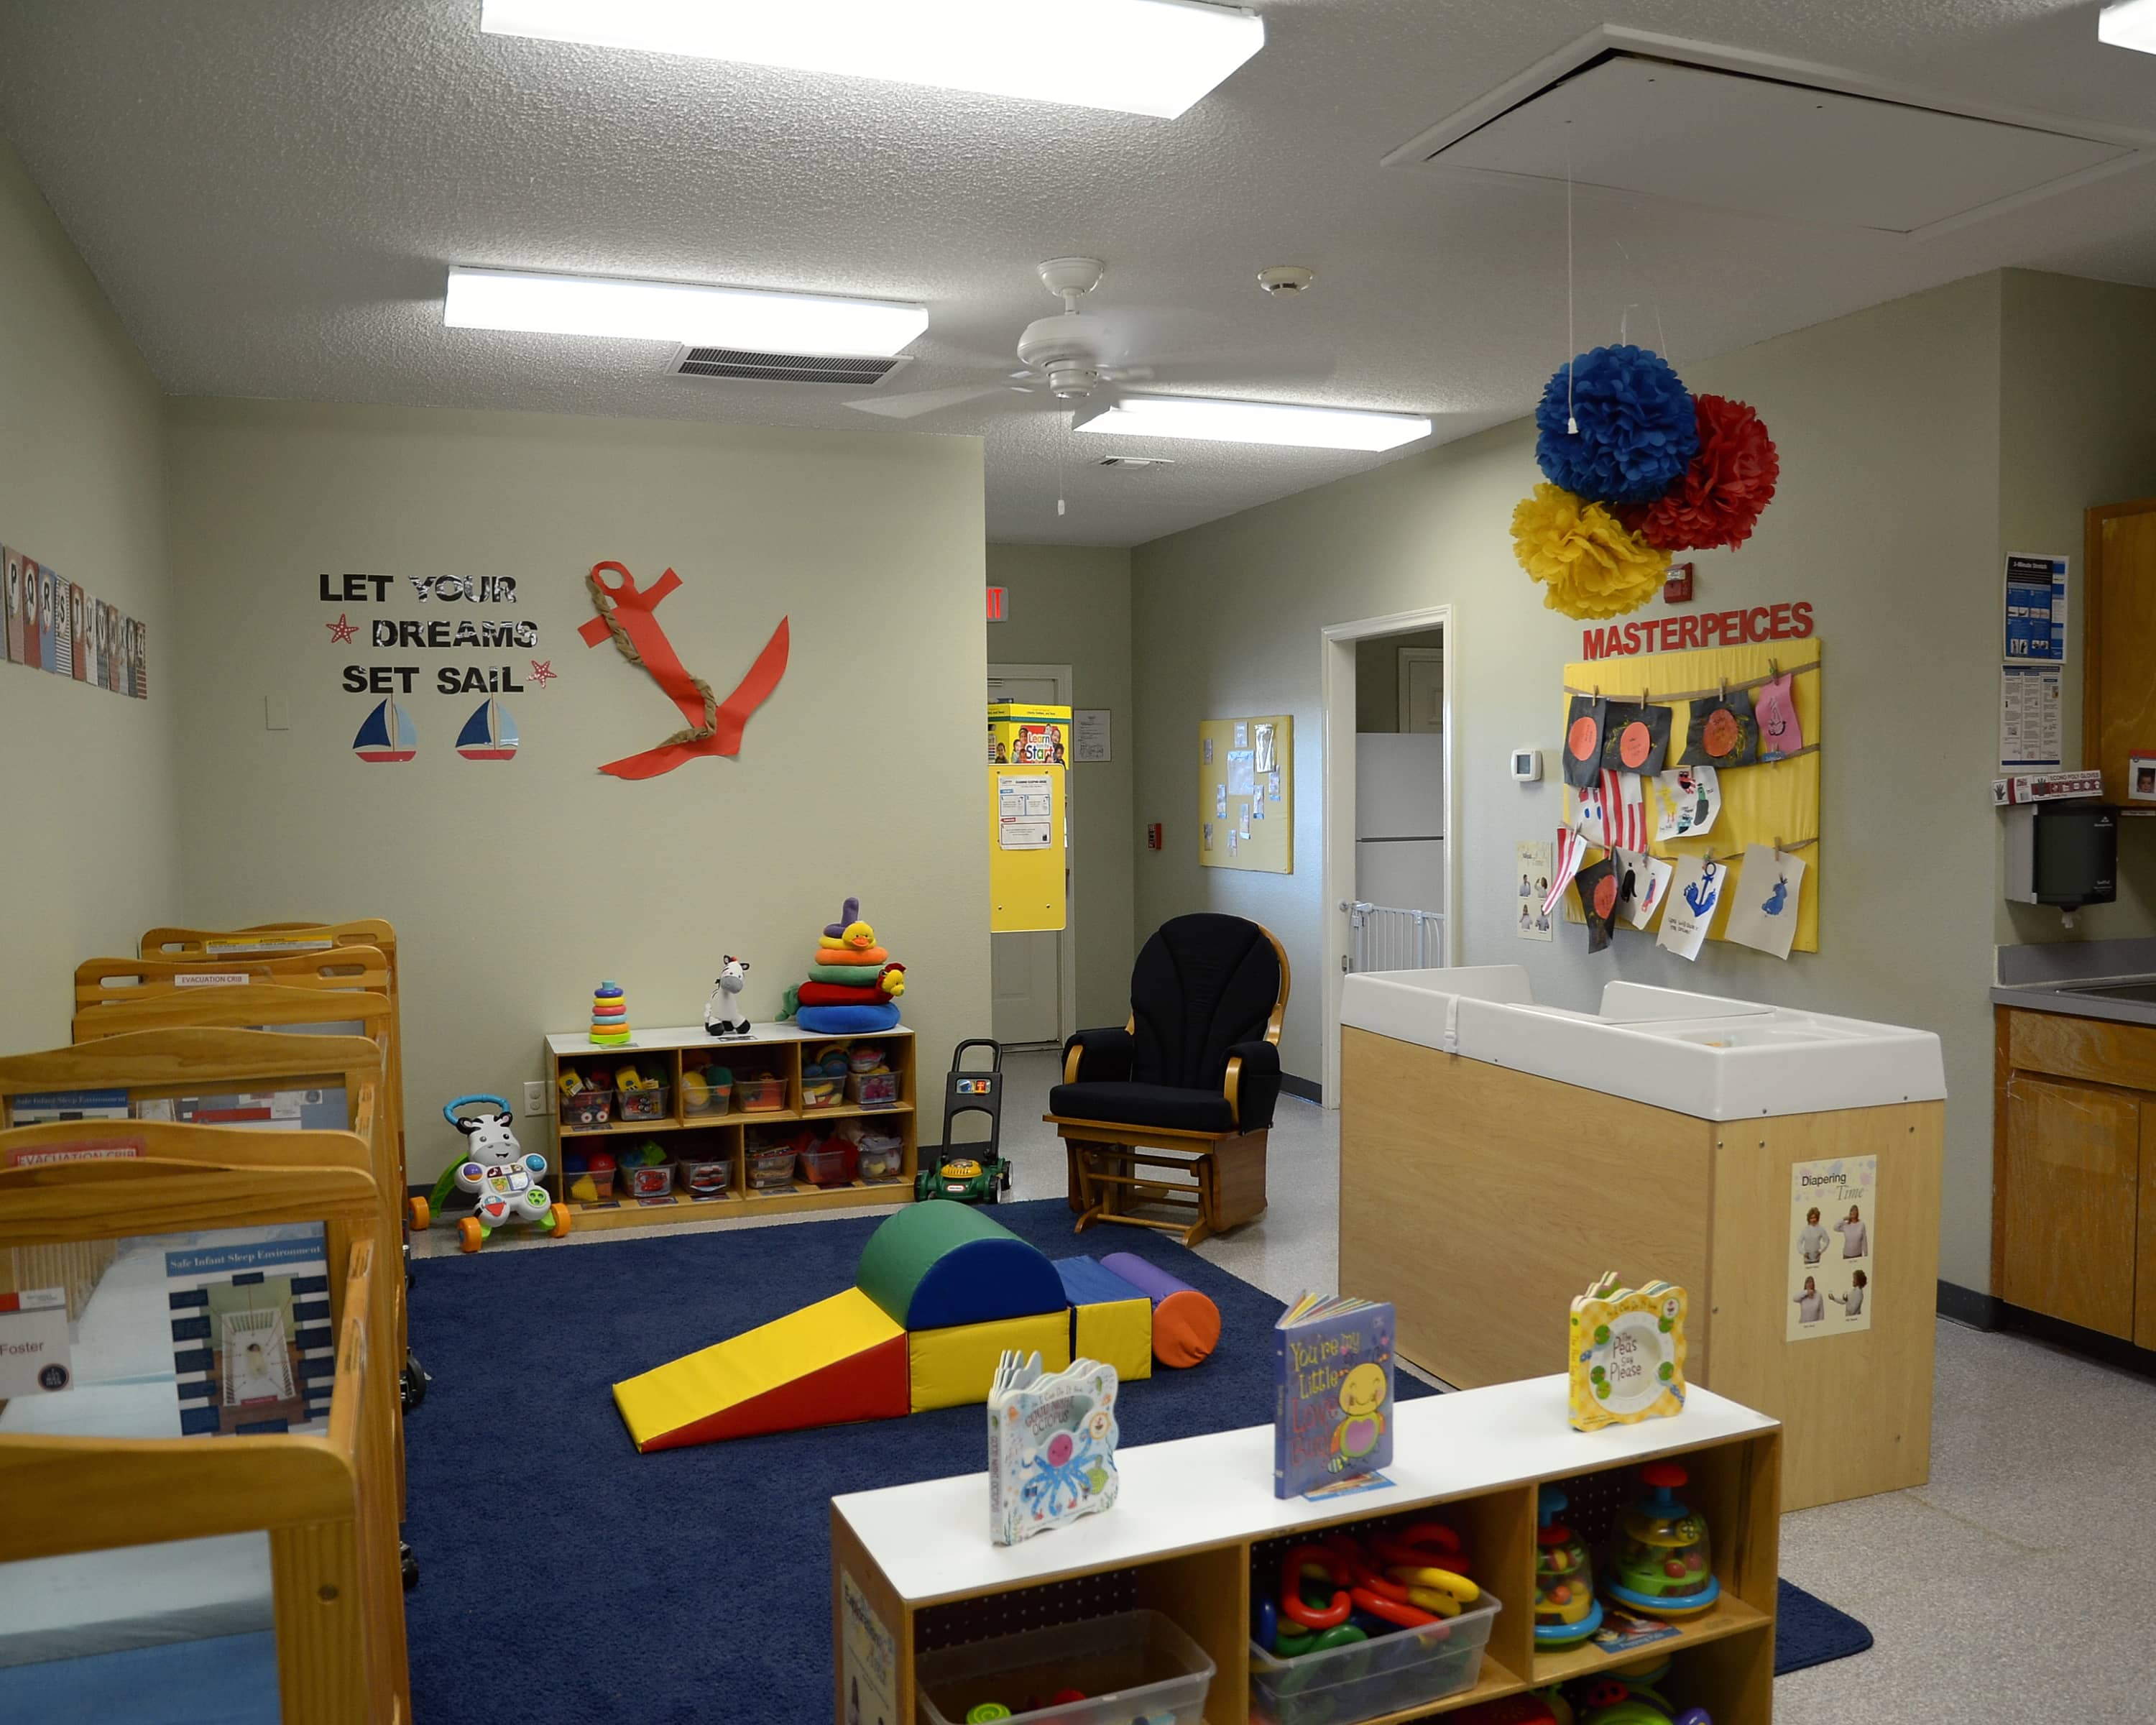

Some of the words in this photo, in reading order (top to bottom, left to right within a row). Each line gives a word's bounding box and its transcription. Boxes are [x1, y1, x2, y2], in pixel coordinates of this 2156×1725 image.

[11, 563, 17, 594] P
[27, 574, 34, 606] Q
[44, 581, 50, 612] R
[60, 595, 65, 623] S
[320, 574, 394, 602] LET
[409, 575, 517, 602] YOUR
[987, 588, 1003, 618] IT
[372, 620, 538, 648] DREAMS
[1583, 602, 1813, 661] MASTERPEICES
[342, 666, 420, 694] SET
[437, 666, 524, 694] SAIL
[1028, 732, 1050, 743] Learn
[1026, 745, 1054, 760] Start
[1802, 1173, 1847, 1187] Diapering
[1836, 1185, 1865, 1201] Time
[170, 1259, 192, 1269] Safe
[195, 1256, 225, 1267] Infant
[228, 1253, 255, 1264] Sleep
[257, 1245, 321, 1259] Environment
[0, 1341, 44, 1356] Foster
[1291, 1333, 1340, 1372] You're
[1613, 1336, 1638, 1358] Peas
[1299, 1368, 1338, 1399] Little
[1611, 1362, 1641, 1381] Please
[1032, 1409, 1069, 1435] OCTOPUS
[1291, 1397, 1338, 1433] Love
